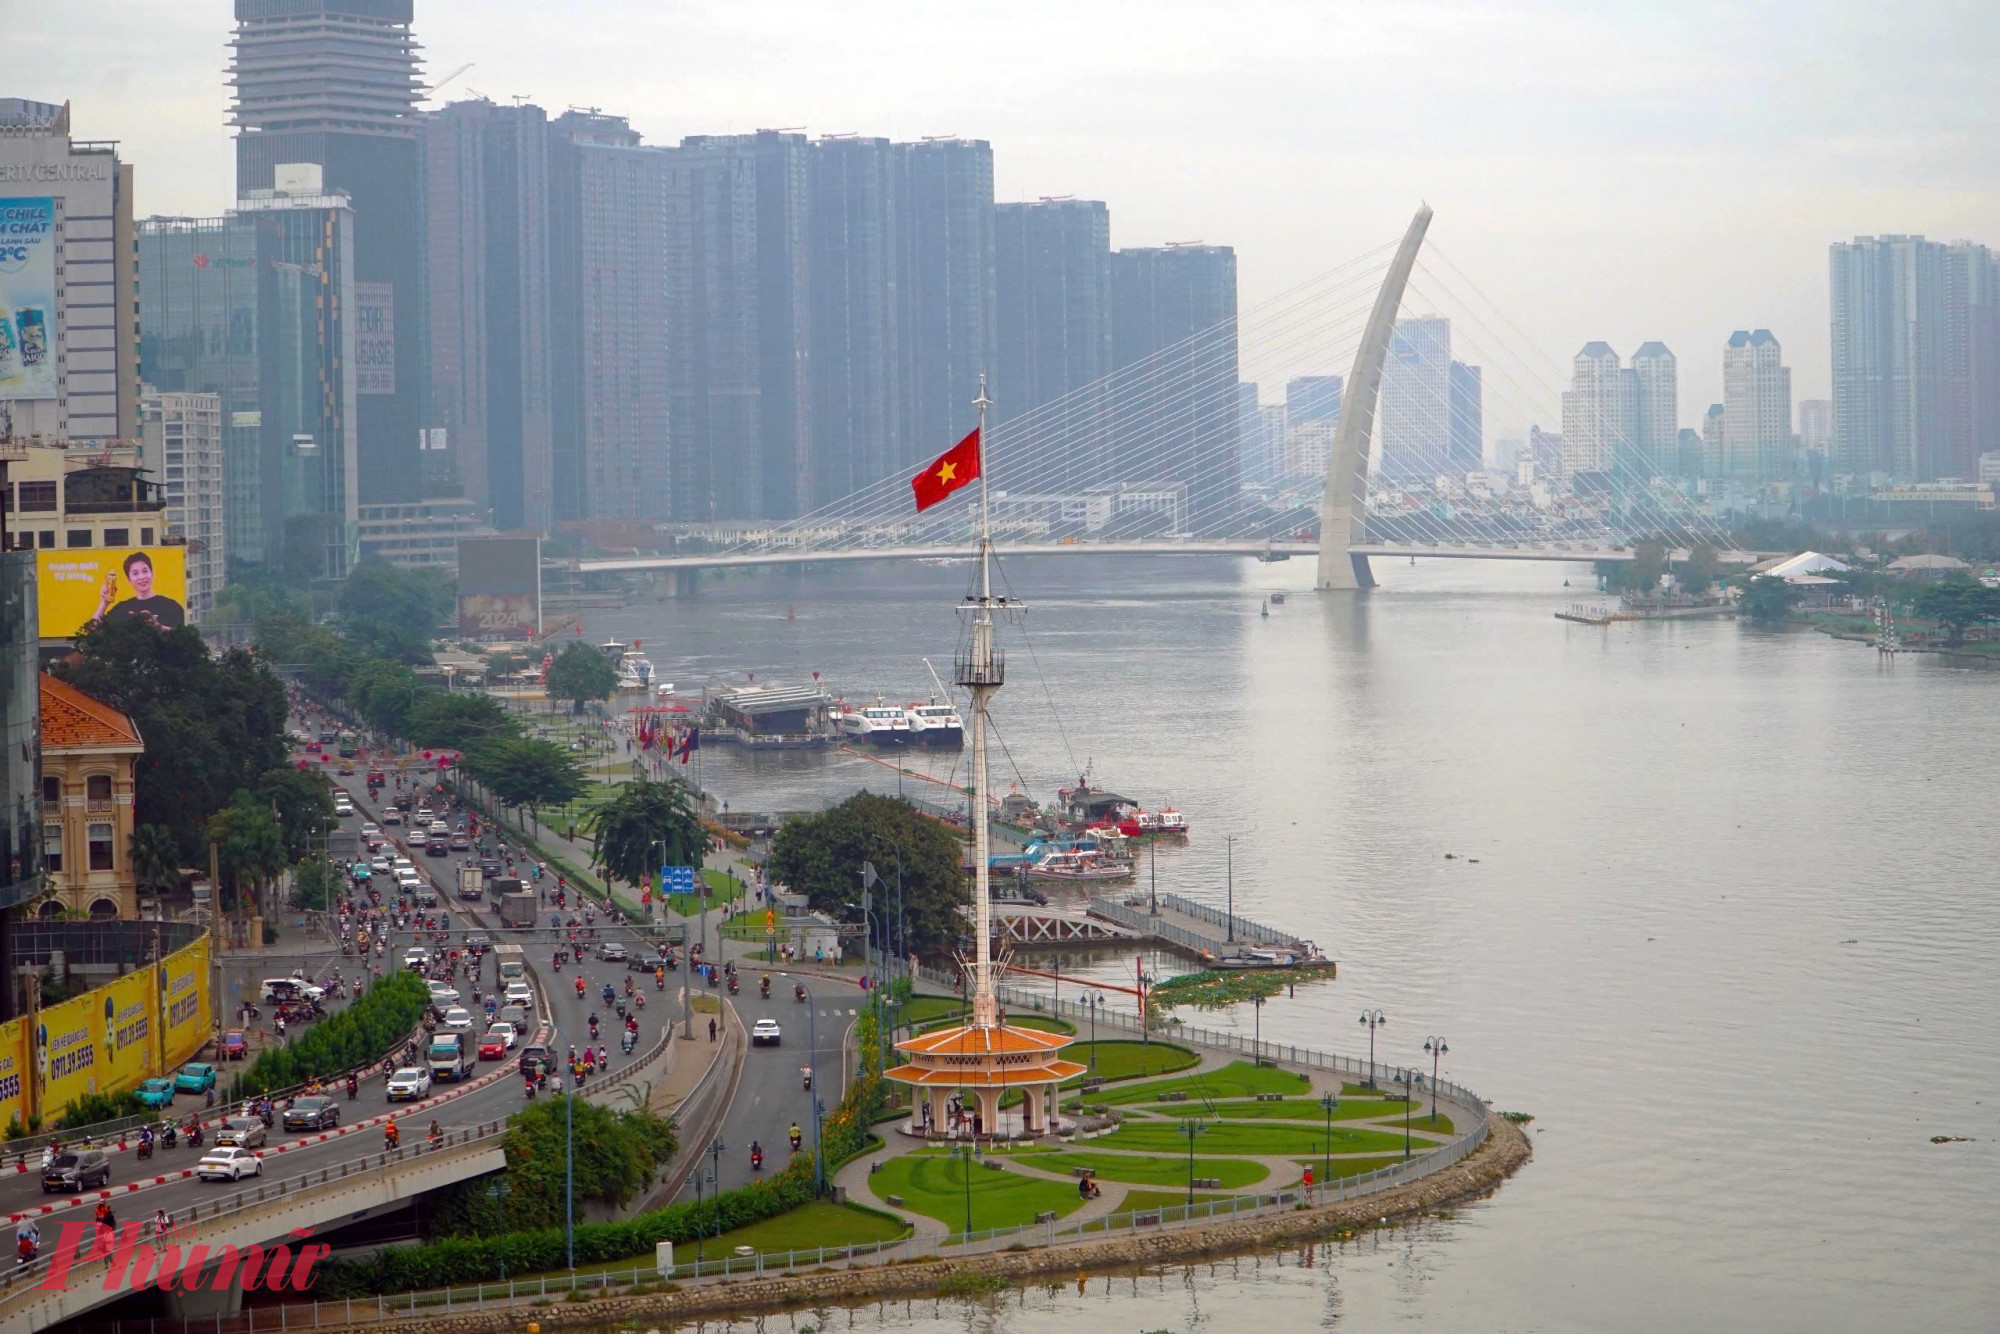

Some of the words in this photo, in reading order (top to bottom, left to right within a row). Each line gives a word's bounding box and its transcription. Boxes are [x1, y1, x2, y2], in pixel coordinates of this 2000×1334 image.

[36, 163, 107, 181] CENTRAL
[5, 207, 46, 220] CHILL
[479, 612, 519, 628] 2024
[51, 1044, 94, 1081] 0911.39.5555
